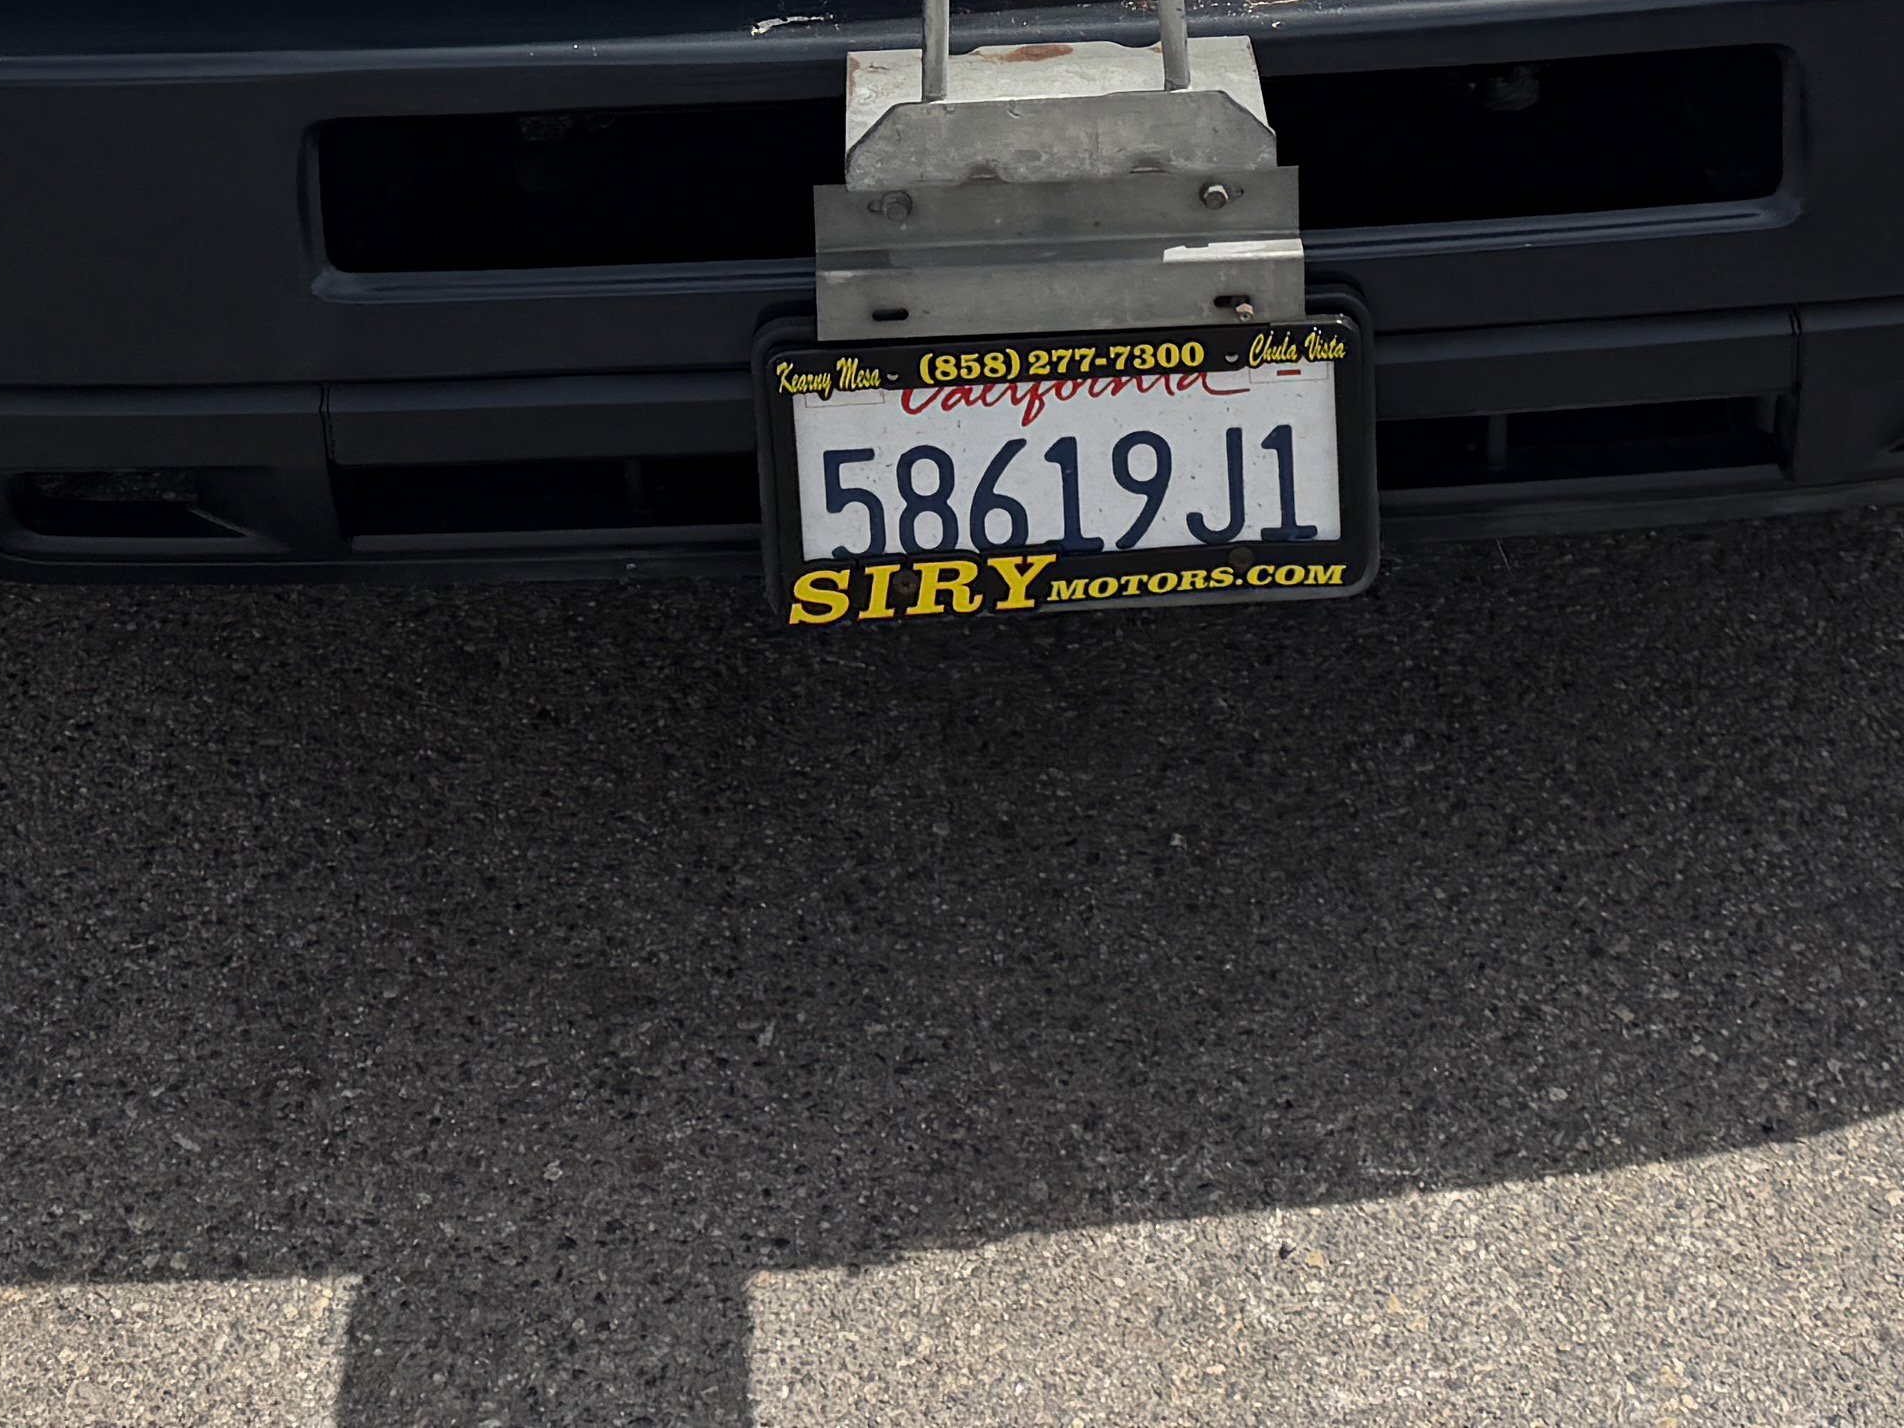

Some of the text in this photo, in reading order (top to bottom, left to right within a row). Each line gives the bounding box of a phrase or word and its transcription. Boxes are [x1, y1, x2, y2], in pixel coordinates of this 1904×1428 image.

[776, 327, 1346, 399] Kearny Mesa (858) 277-7300 Chula Vista
[823, 423, 1318, 561] 58619J1
[788, 553, 1347, 625] SIRY MOTORS.COM
